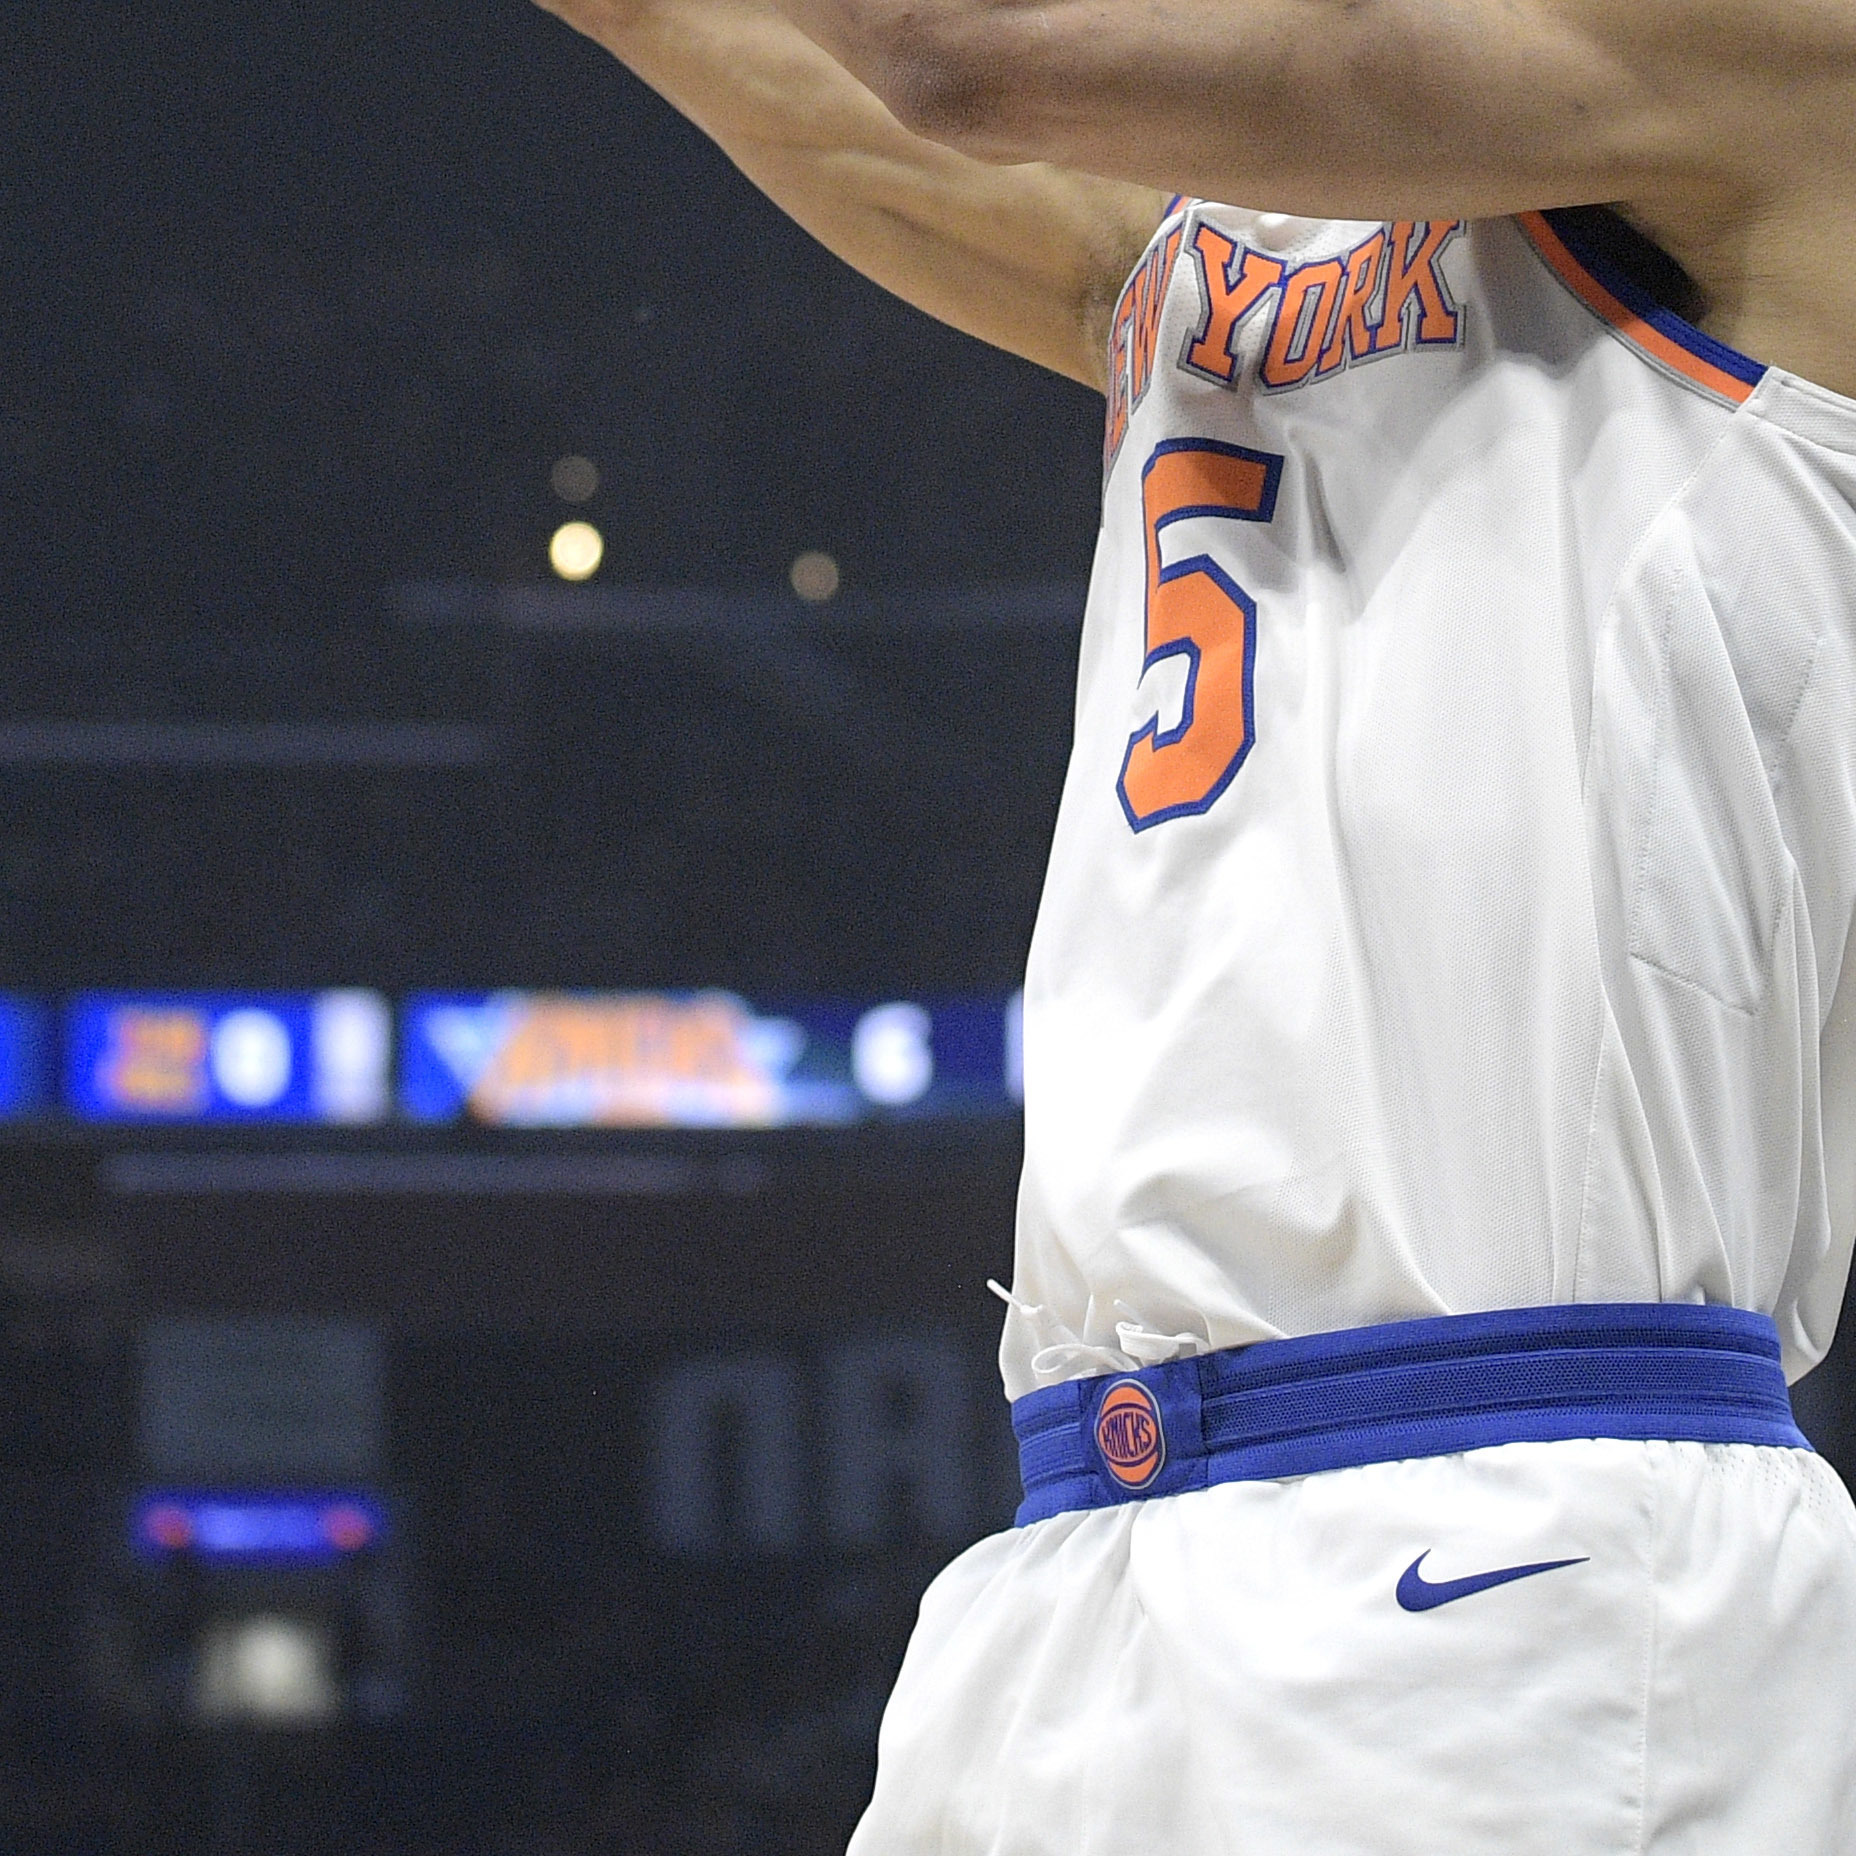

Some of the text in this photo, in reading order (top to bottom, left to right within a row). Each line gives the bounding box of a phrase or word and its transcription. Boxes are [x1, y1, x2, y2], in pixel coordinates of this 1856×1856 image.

[1104, 211, 1466, 479] EW YORK
[1116, 436, 1285, 835] 5
[1101, 1410, 1153, 1459] KNICKS
